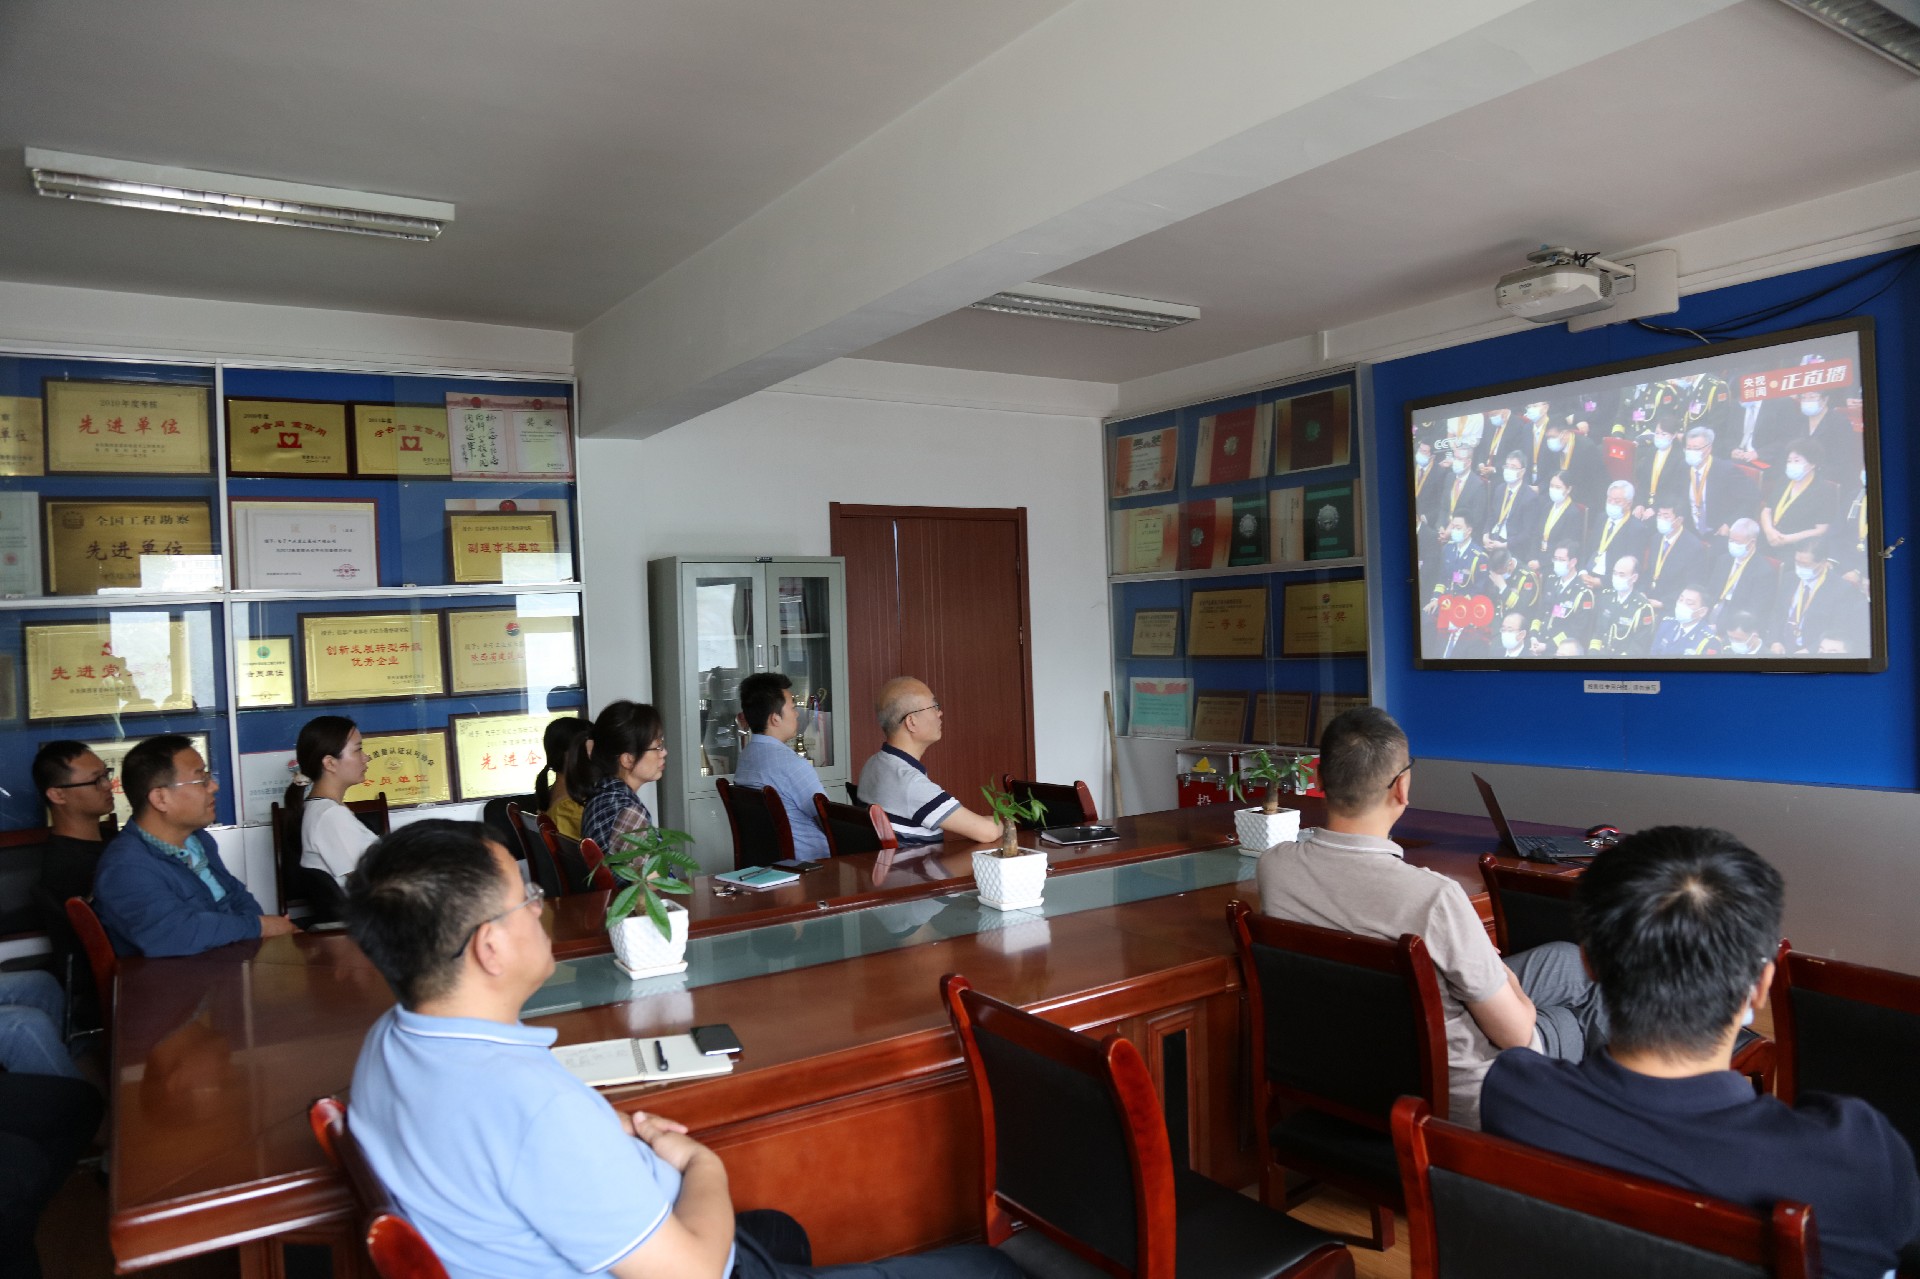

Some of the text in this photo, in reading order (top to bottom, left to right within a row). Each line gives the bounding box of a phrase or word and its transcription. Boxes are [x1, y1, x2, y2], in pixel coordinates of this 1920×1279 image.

[1744, 376, 1766, 388] 央视
[1781, 366, 1847, 391] 正直播
[79, 414, 181, 435] 先进单位
[96, 515, 190, 526] 全国工程勘察
[86, 539, 185, 560] 先进单位
[468, 542, 541, 553] 副理事长单位
[326, 643, 422, 655] 创新发展转型升级
[351, 656, 399, 667] 优秀企业
[362, 774, 428, 786] 会员单位
